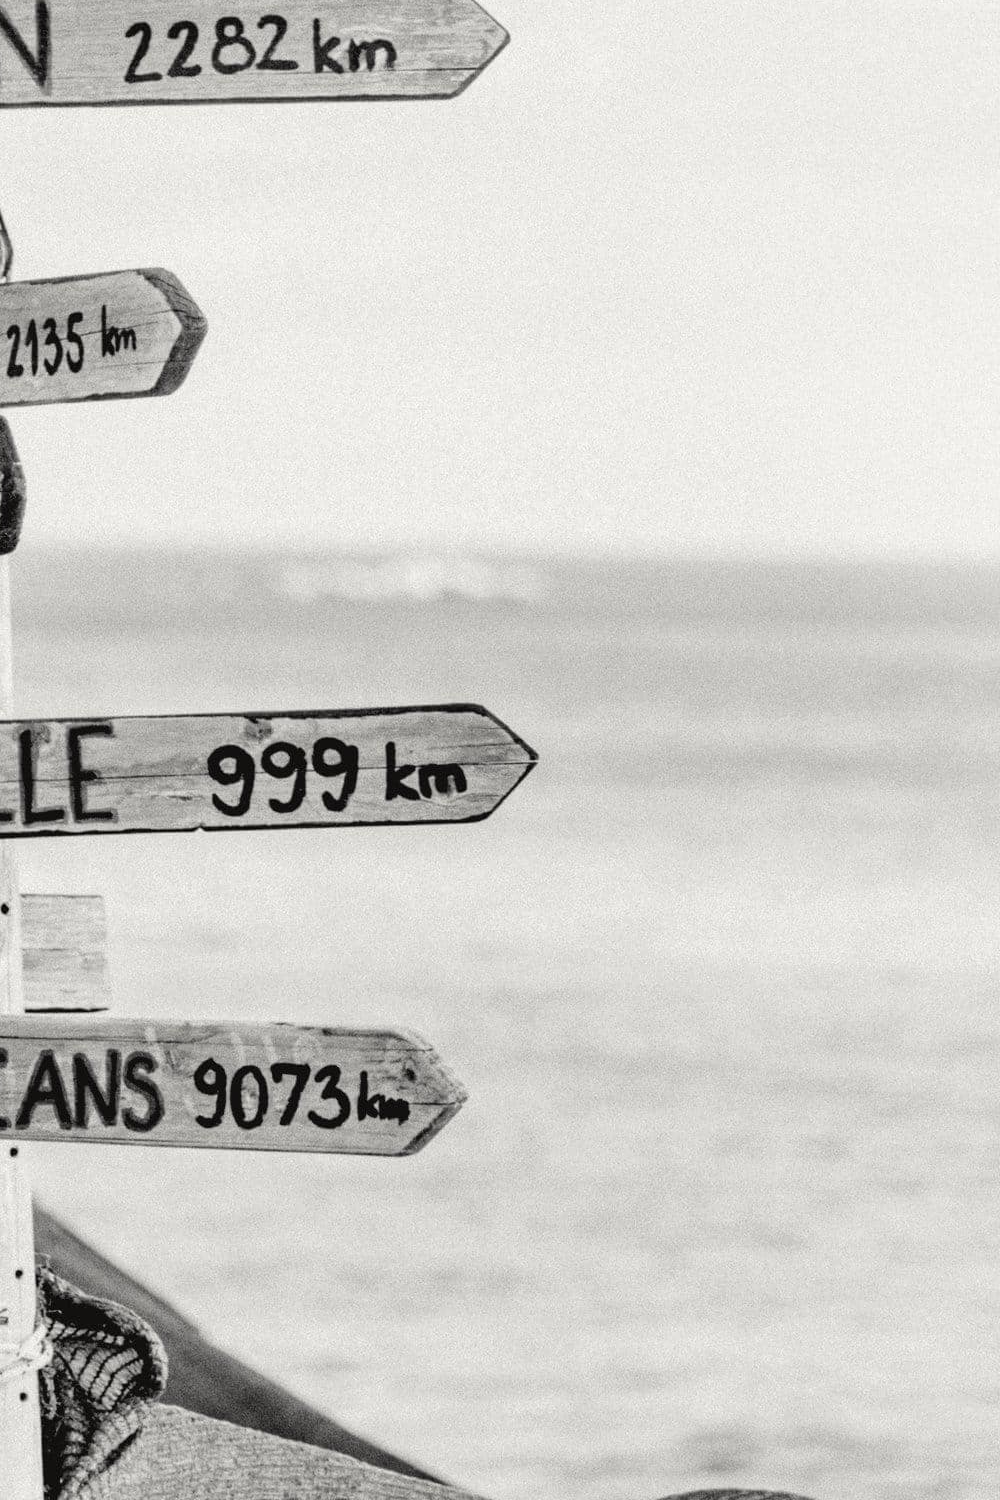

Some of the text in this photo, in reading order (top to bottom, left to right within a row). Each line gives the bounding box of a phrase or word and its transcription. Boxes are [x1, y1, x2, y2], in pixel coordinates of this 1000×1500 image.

[123, 13, 299, 85] 2282
[311, 17, 398, 75] km
[6, 311, 85, 379] 2135
[100, 305, 138, 358] km
[206, 736, 359, 817] 999
[382, 741, 468, 803] km
